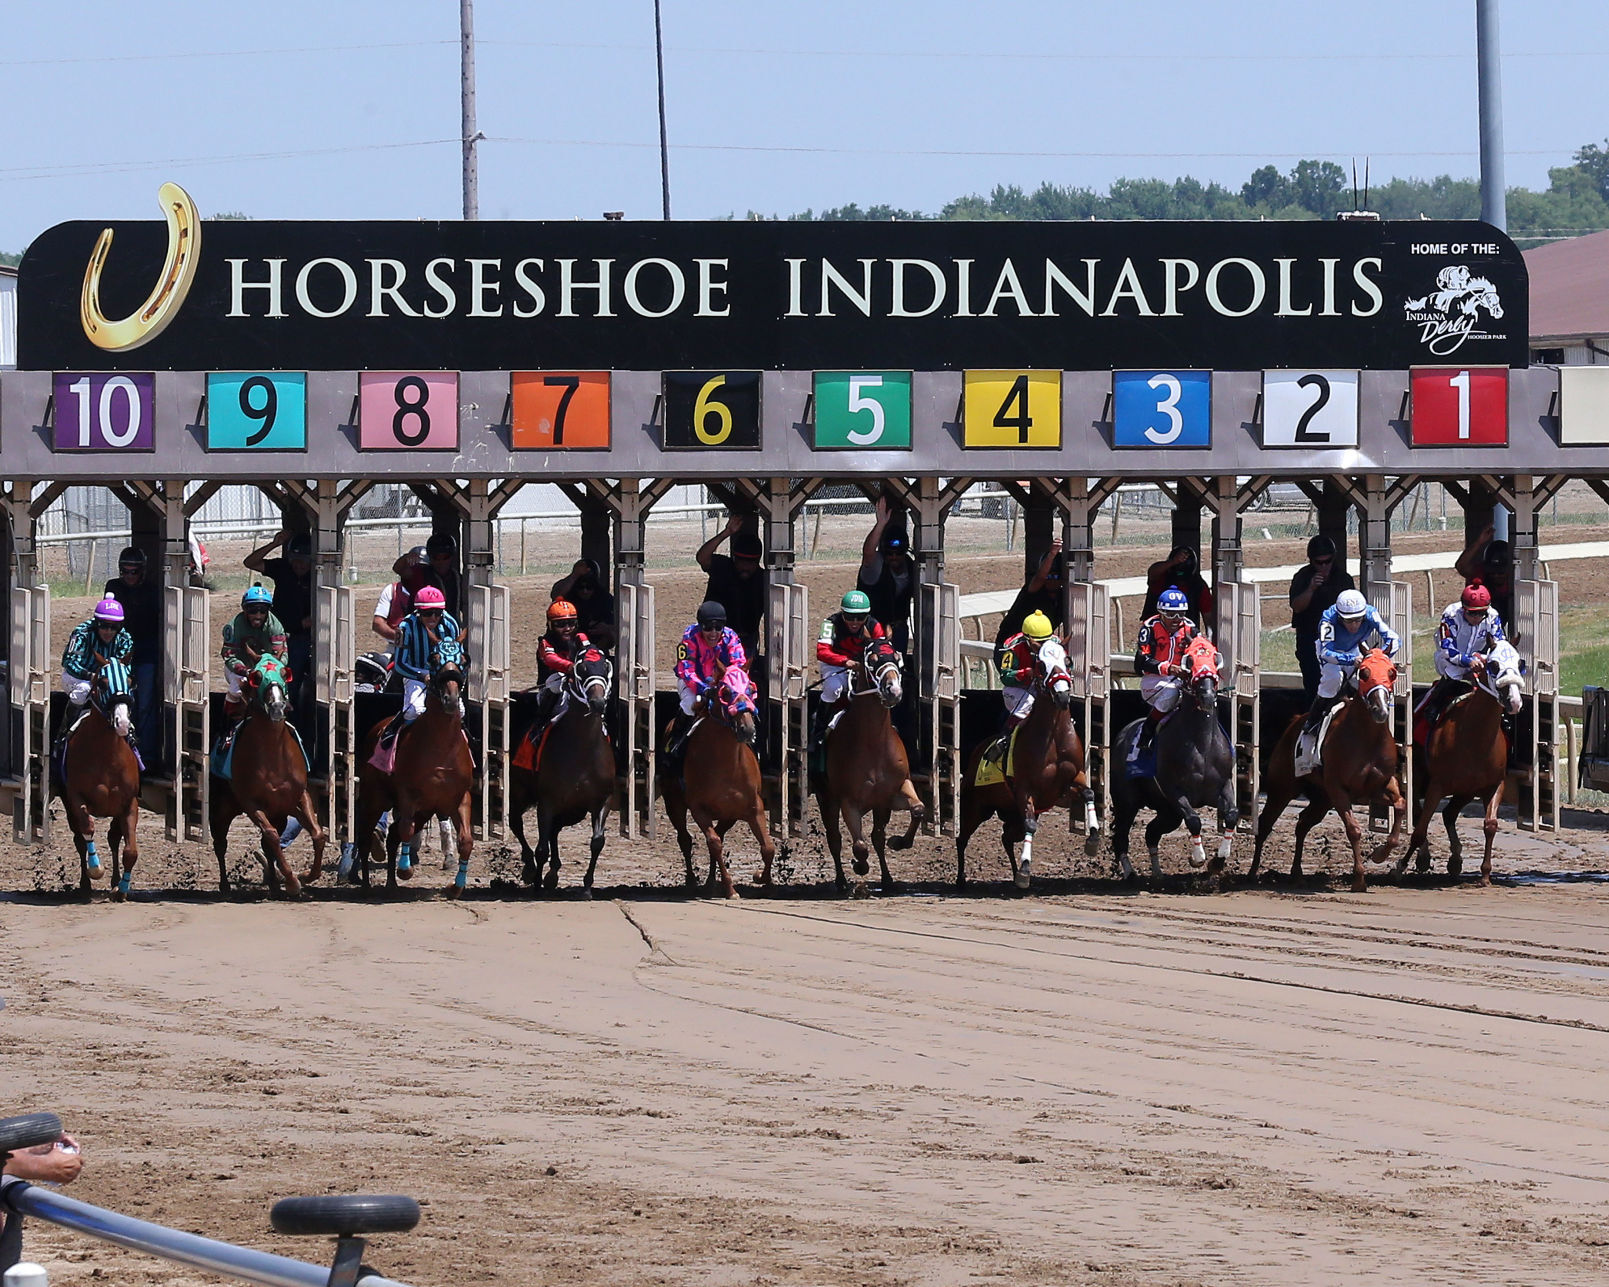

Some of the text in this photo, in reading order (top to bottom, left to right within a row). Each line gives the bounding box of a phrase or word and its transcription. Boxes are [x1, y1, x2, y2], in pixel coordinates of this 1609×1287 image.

[1411, 243, 1500, 255] HOME OF THE:
[224, 257, 1382, 319] HORSESHOE INDIANAPOLIS
[1405, 311, 1446, 321] INDIANA
[1417, 315, 1487, 355] Derby
[70, 375, 140, 447] 10
[239, 375, 278, 447] 9
[393, 375, 430, 447] 8
[543, 376, 580, 446] 7
[693, 375, 732, 446] 6
[847, 375, 884, 445] 5
[993, 374, 1032, 443] 4
[1144, 373, 1183, 444] 3
[1295, 374, 1330, 442] 2
[1450, 371, 1470, 439] 1
[678, 644, 687, 660] 6
[822, 622, 834, 638] 5
[1002, 652, 1012, 667] 4
[1139, 628, 1149, 642] 3
[1324, 626, 1332, 640] 2
